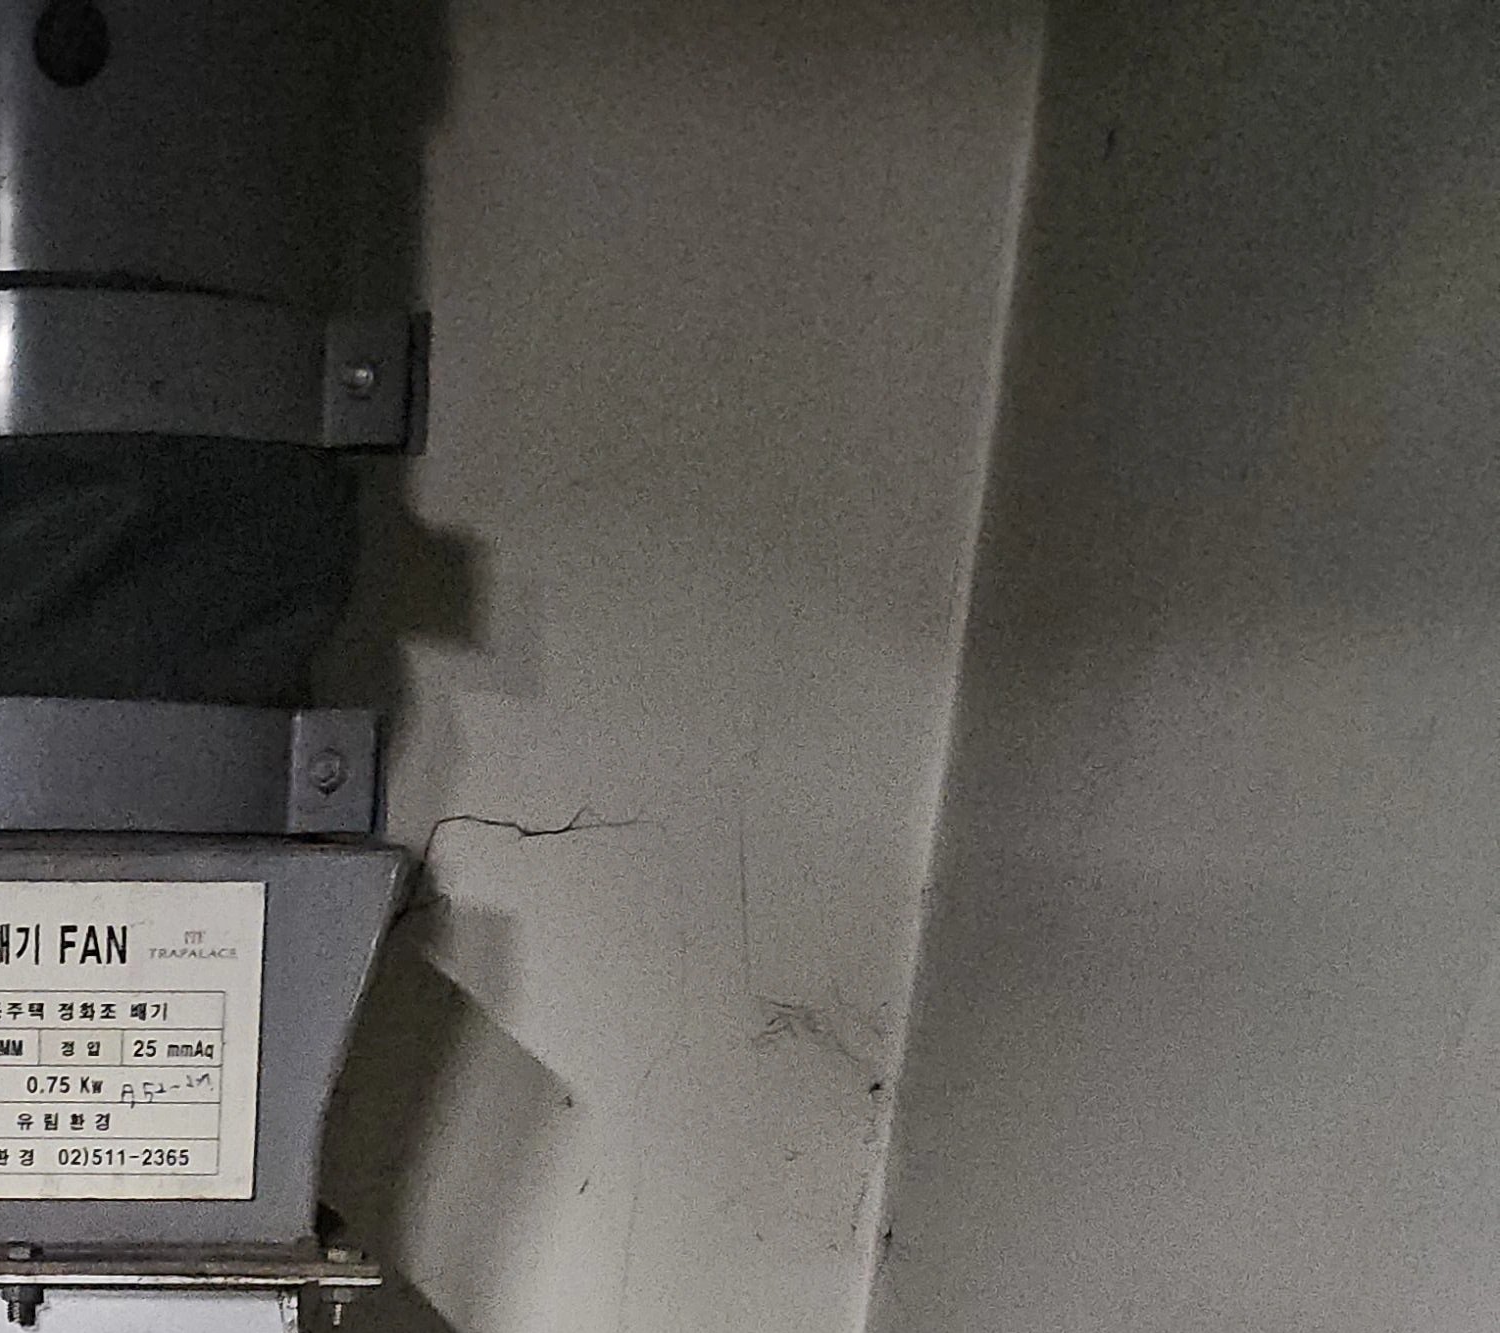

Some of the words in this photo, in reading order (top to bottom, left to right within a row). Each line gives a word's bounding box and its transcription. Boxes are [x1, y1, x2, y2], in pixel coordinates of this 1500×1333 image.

[59, 925, 128, 964] FAN
[57, 1003, 116, 1021] 정화조
[130, 1003, 168, 1021] 배기
[133, 1039, 157, 1058] 25
[167, 1040, 214, 1059] mmAq
[26, 1076, 70, 1094] 0.75
[58, 1148, 189, 1167] 02)511-2365
